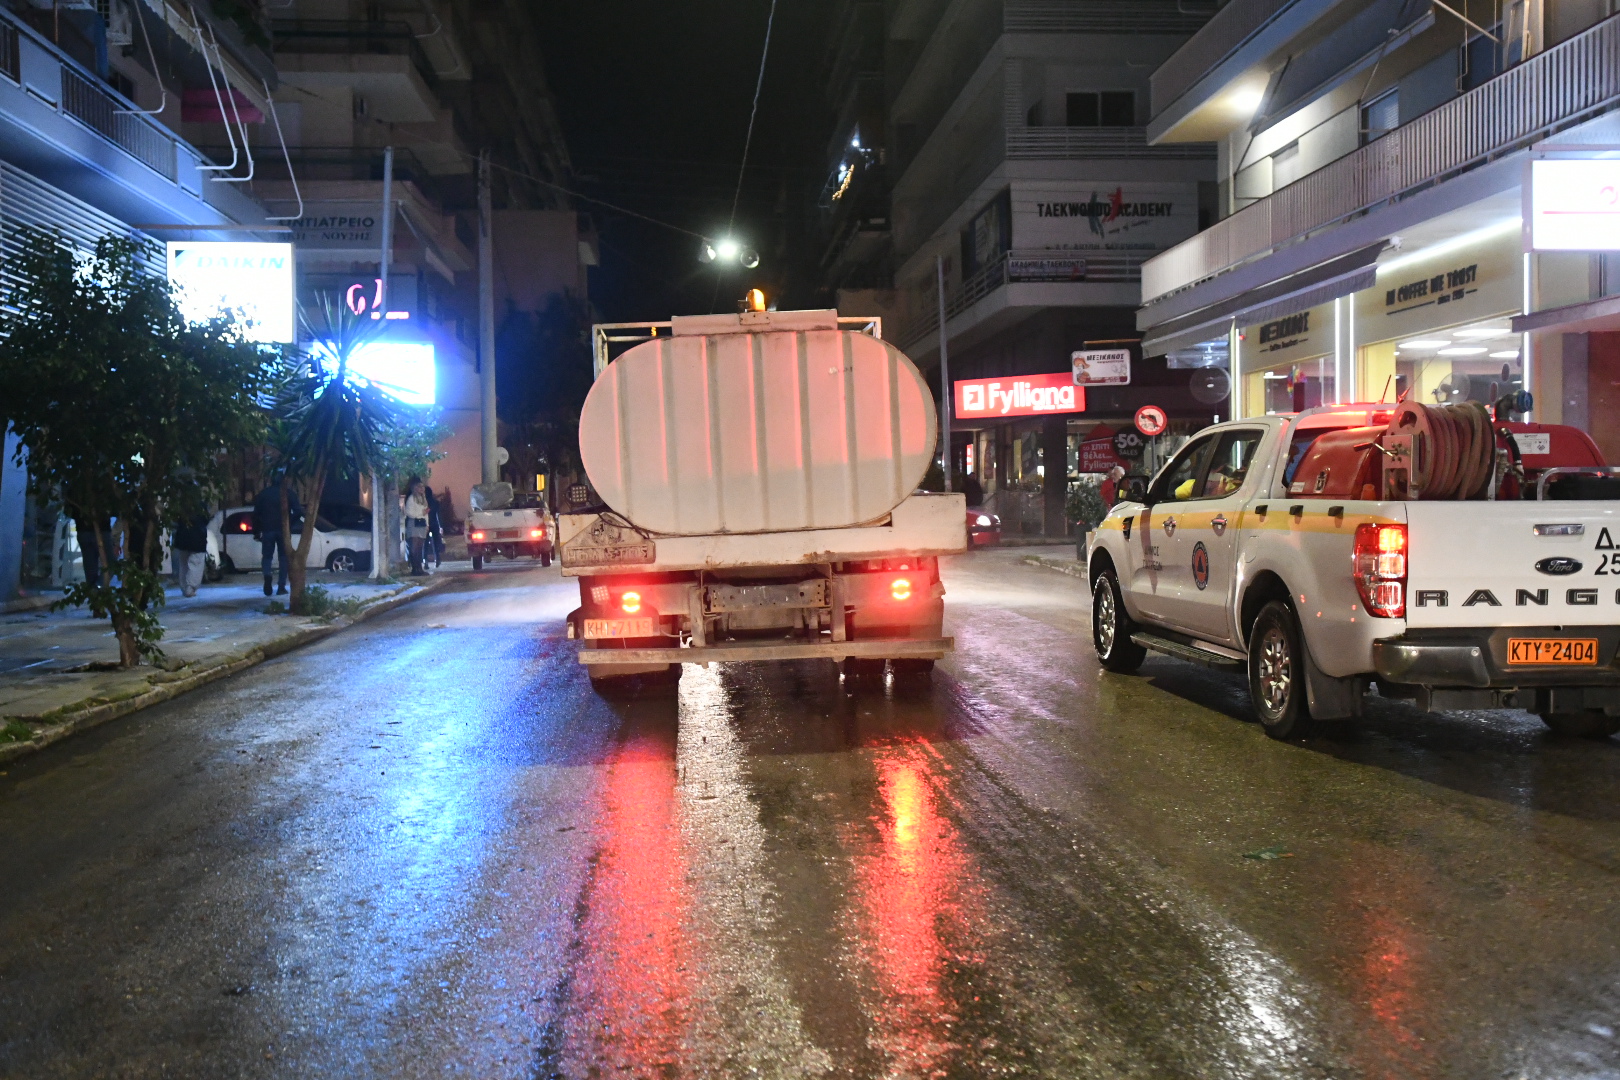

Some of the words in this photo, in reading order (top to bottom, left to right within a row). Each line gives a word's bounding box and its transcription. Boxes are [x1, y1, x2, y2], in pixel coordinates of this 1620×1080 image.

[1117, 203, 1173, 217] ACADEMY
[196, 256, 286, 270] DAIKIN
[1397, 279, 1428, 302] COFFEE
[1431, 274, 1445, 293] WE
[1447, 264, 1477, 289] TRUST
[988, 382, 1075, 414] Fylliana
[1114, 433, 1144, 449] -50%
[1118, 448, 1138, 456] SALES
[1083, 460, 1118, 471] Fylliana
[1547, 559, 1574, 572] Ford
[1415, 588, 1620, 607] RANG
